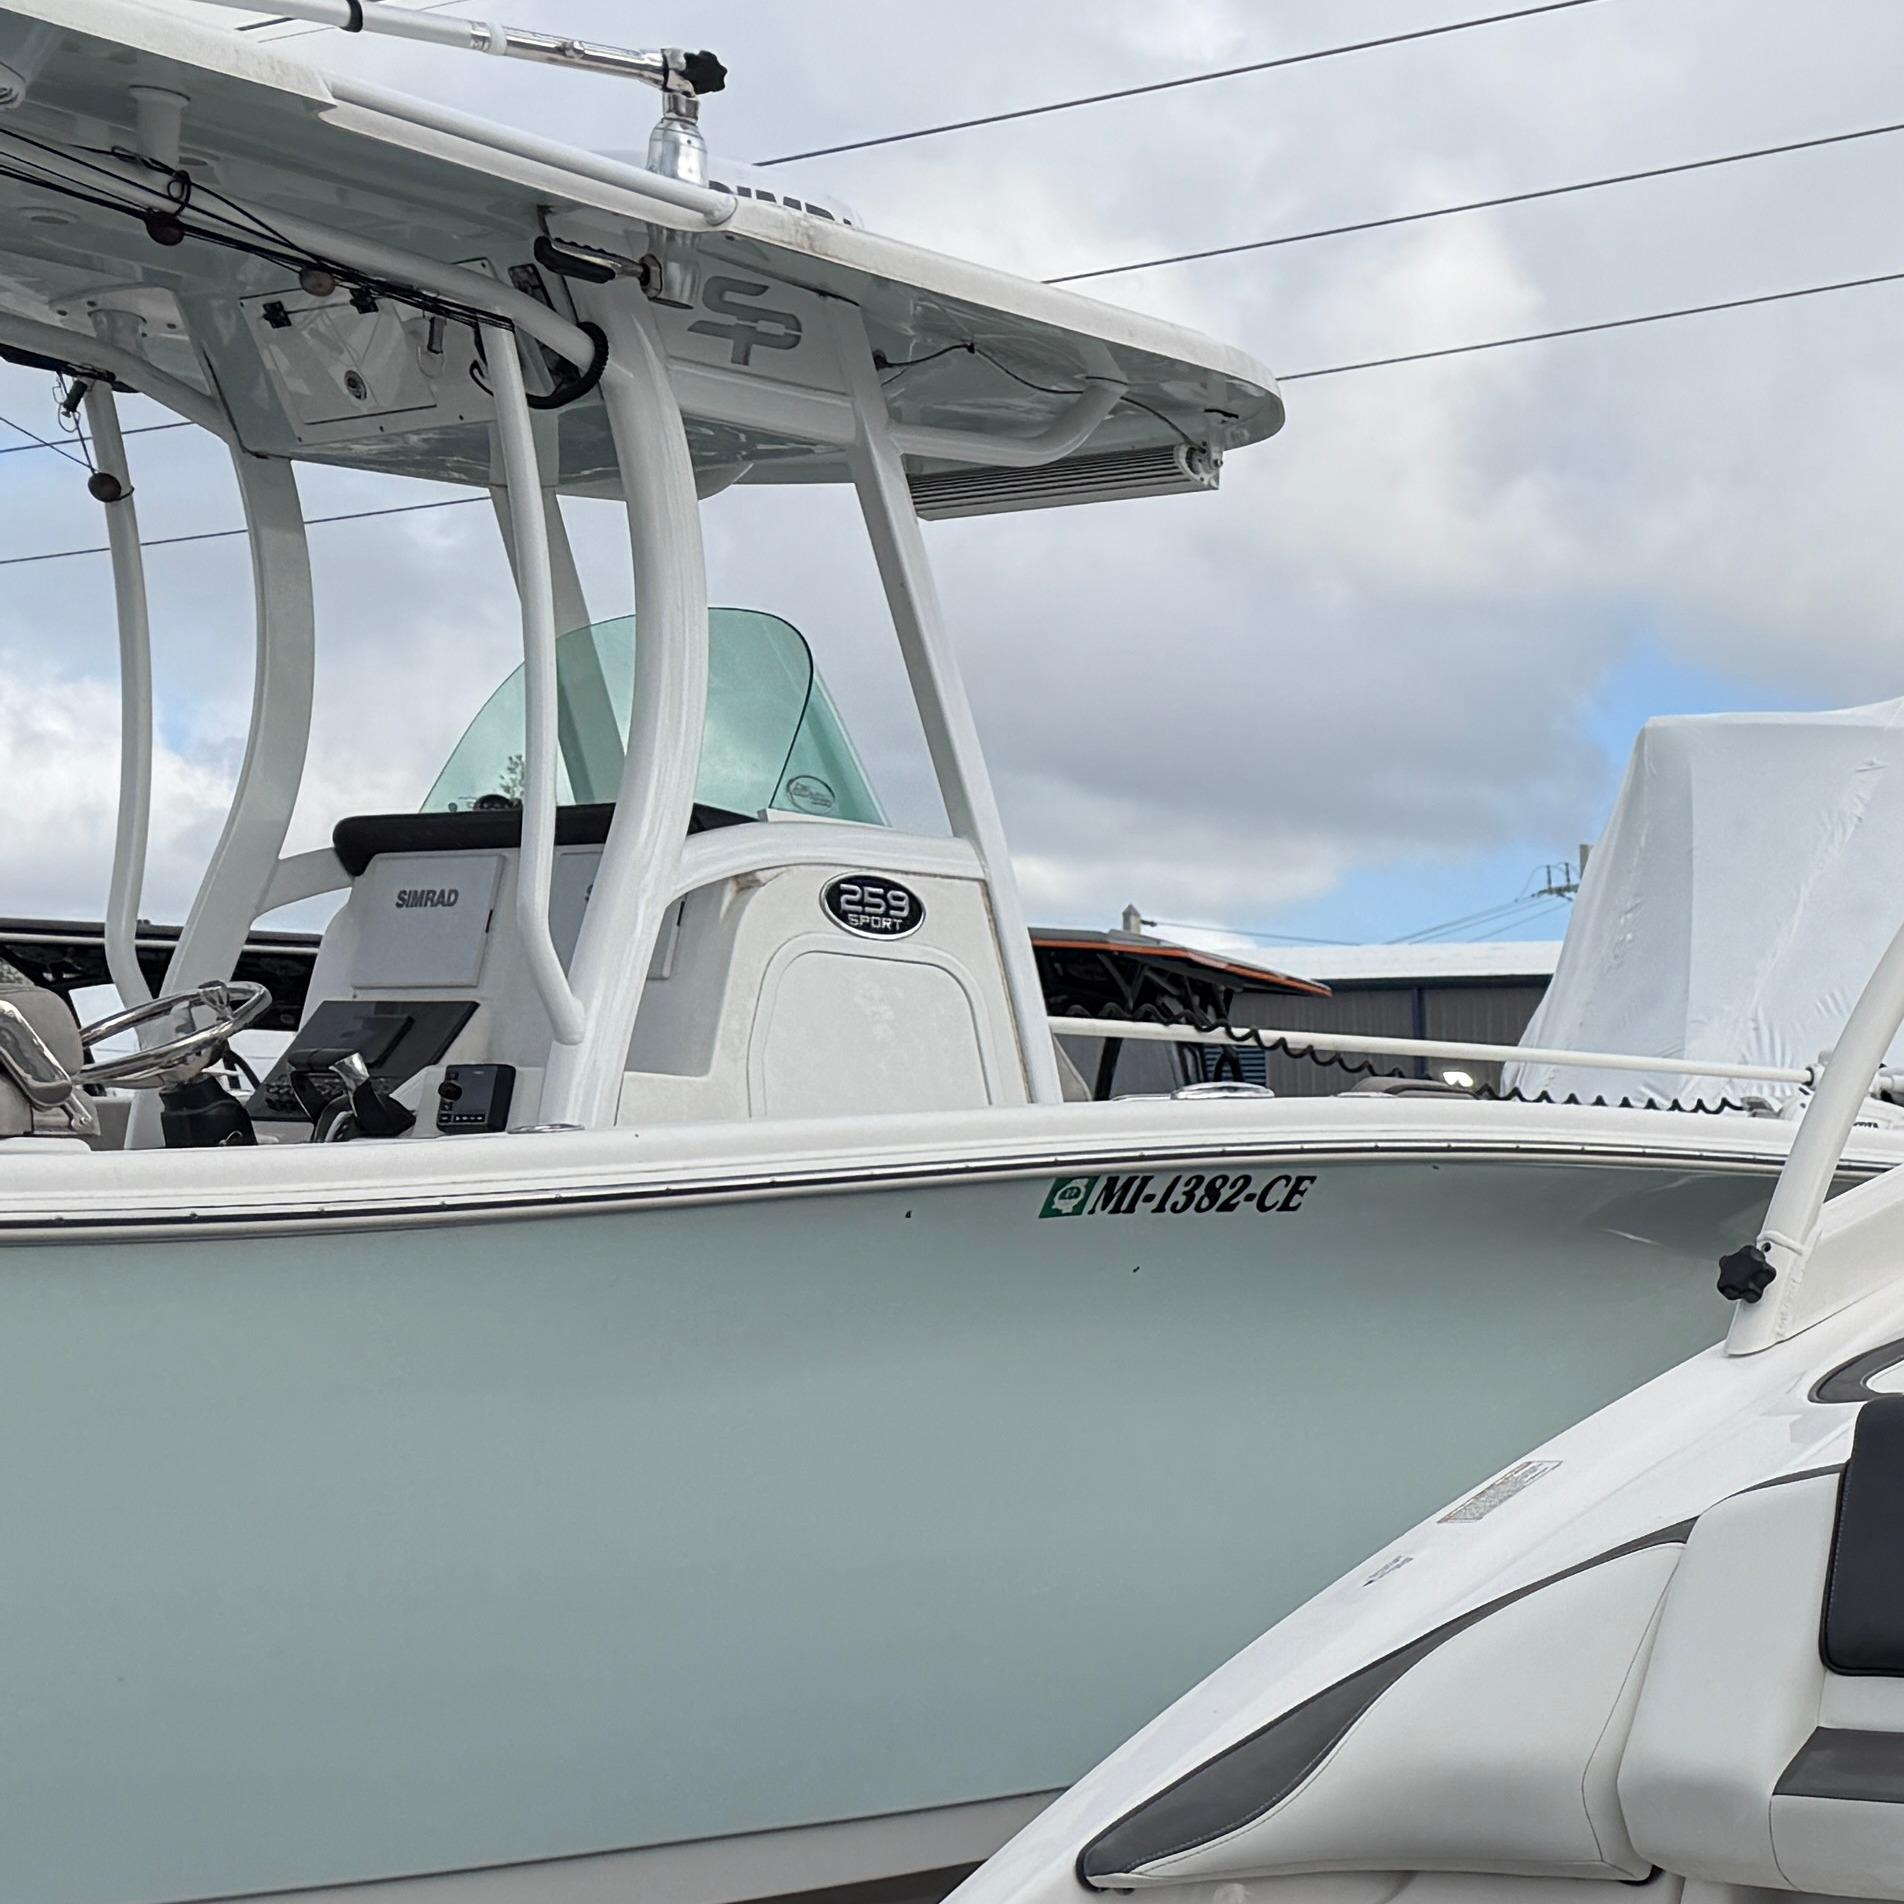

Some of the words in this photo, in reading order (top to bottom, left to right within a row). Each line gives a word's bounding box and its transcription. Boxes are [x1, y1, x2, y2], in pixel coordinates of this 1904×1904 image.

[394, 887, 459, 909] SIMRAD
[838, 883, 910, 917] 259
[846, 912, 906, 932] SPORT
[1088, 1174, 1318, 1215] MI-1382-CE
